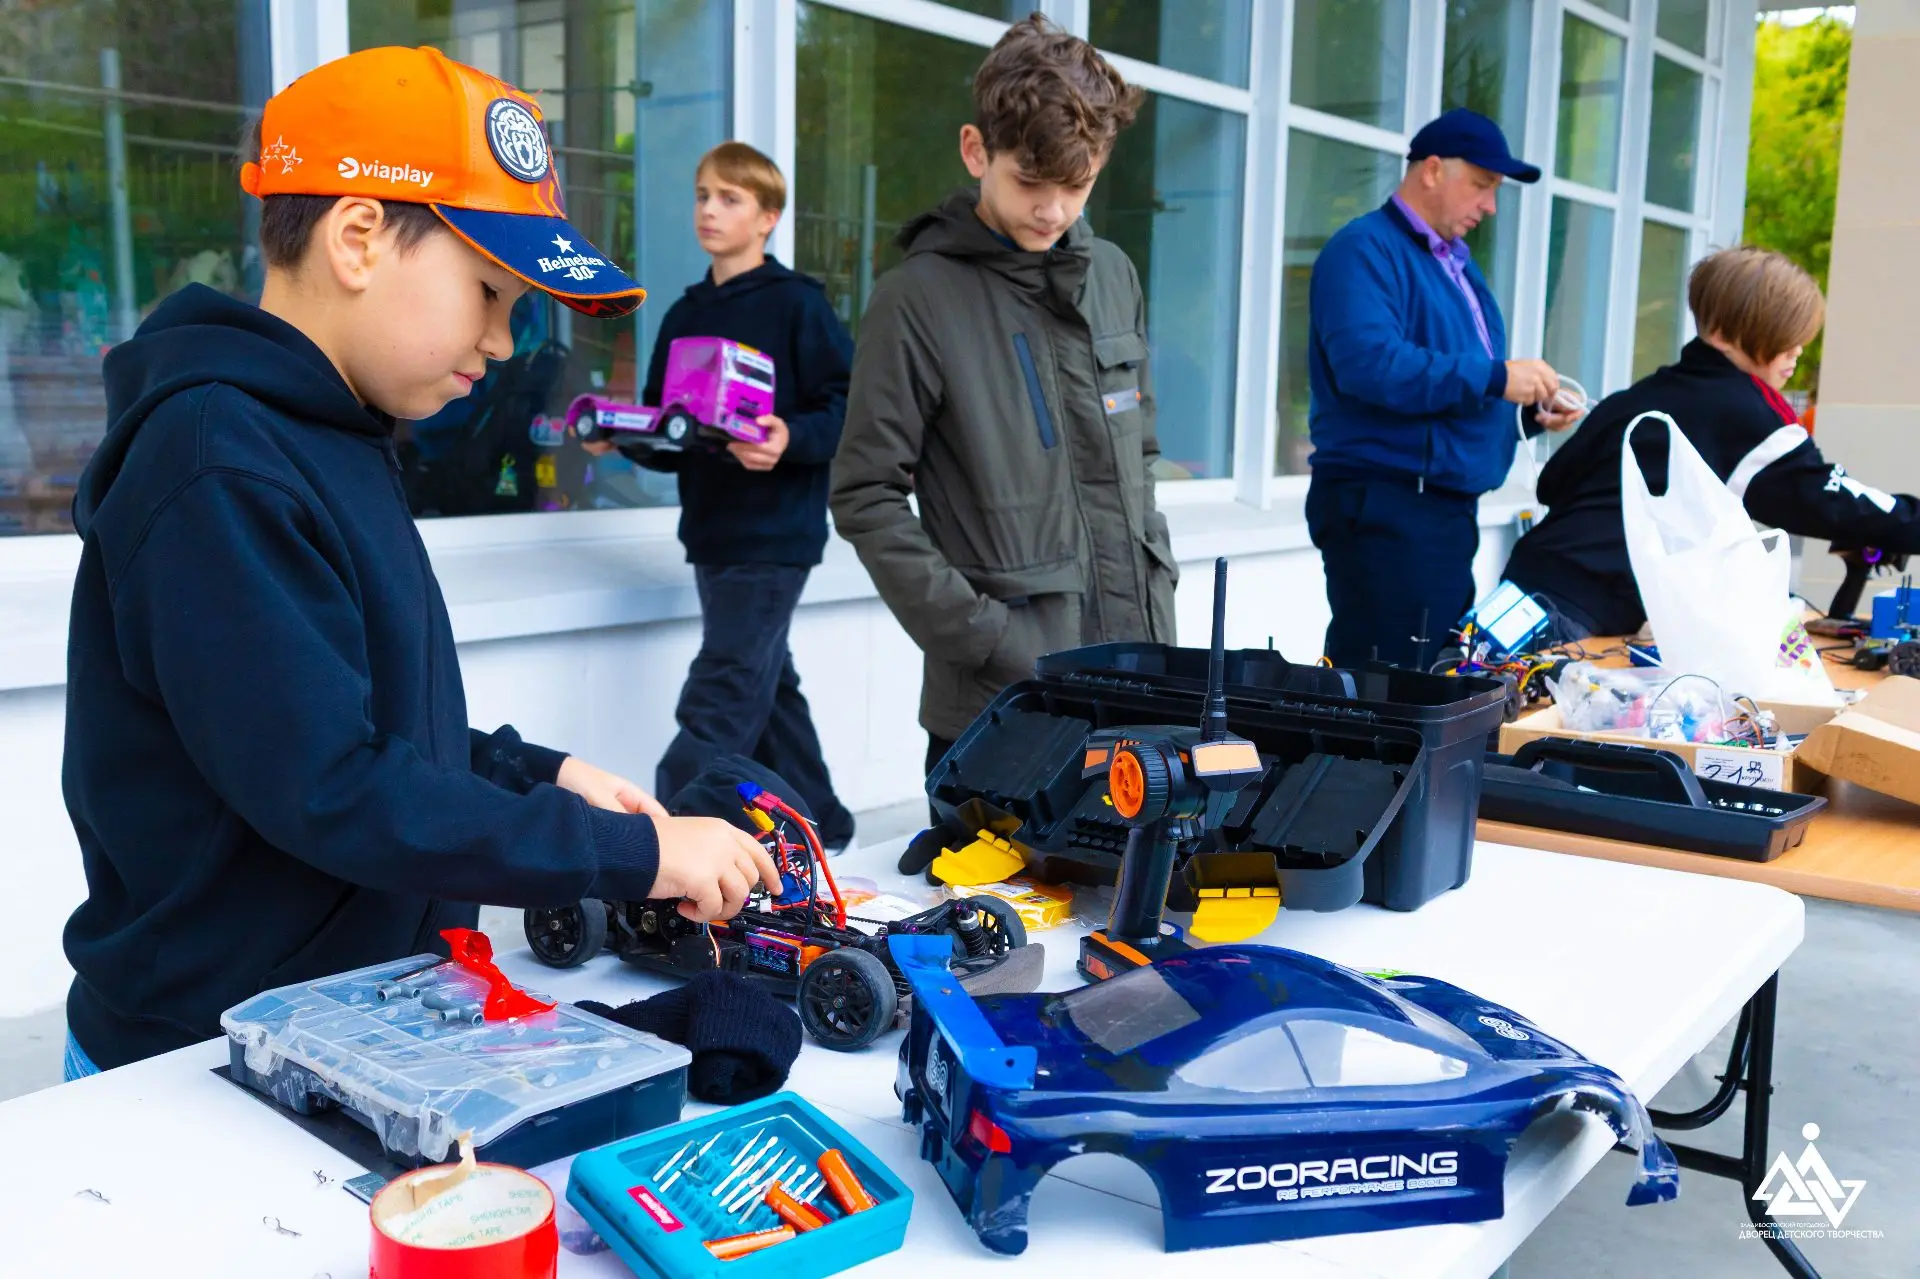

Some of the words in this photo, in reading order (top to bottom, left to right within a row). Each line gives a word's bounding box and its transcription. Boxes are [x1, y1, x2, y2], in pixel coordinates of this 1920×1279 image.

[362, 160, 433, 187] viaplay
[537, 254, 606, 272] Heineken
[1206, 1151, 1458, 1194] ZOORACING
[1300, 1180, 1404, 1199] PERFORMANCE
[1406, 1176, 1458, 1190] BODIES
